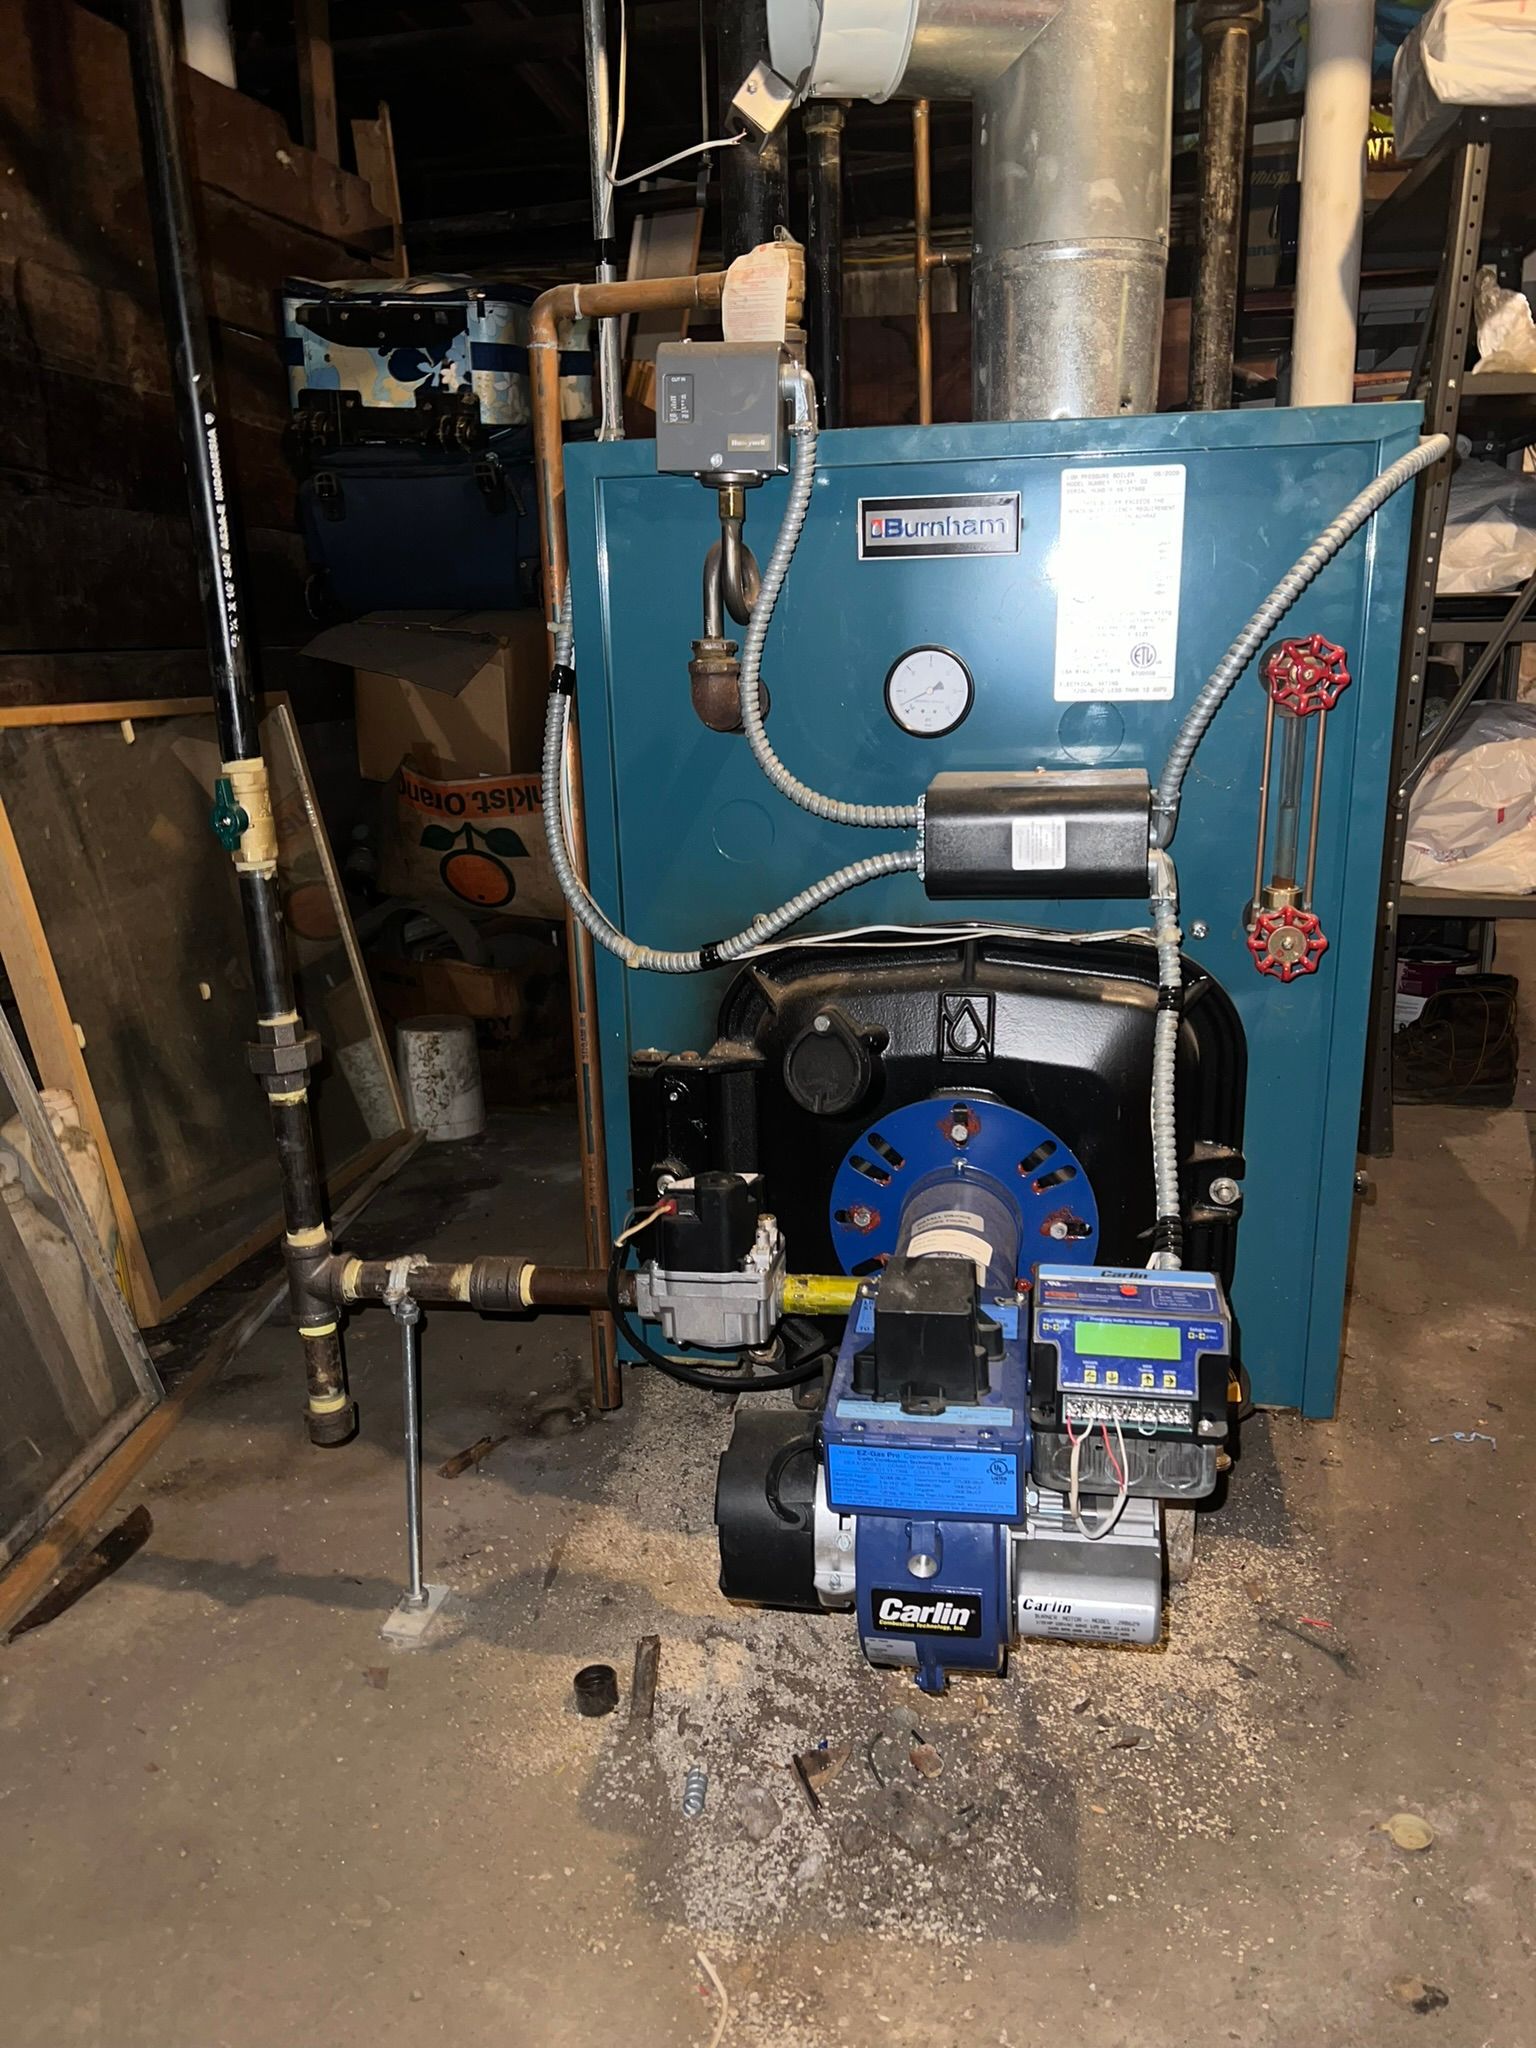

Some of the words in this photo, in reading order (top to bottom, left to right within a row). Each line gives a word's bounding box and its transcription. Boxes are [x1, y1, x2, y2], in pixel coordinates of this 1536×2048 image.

[207, 428, 225, 501] INDONESIA
[1113, 471, 1135, 479] BOILER
[885, 516, 1008, 538] Burnham
[1101, 1270, 1150, 1280] Carlin
[857, 1449, 885, 1458] EZ-Gas
[879, 1598, 971, 1626] Carlin
[1023, 1598, 1072, 1614] Carlin
[879, 1619, 915, 1628] Combustion
[916, 1622, 952, 1631] Technology,
